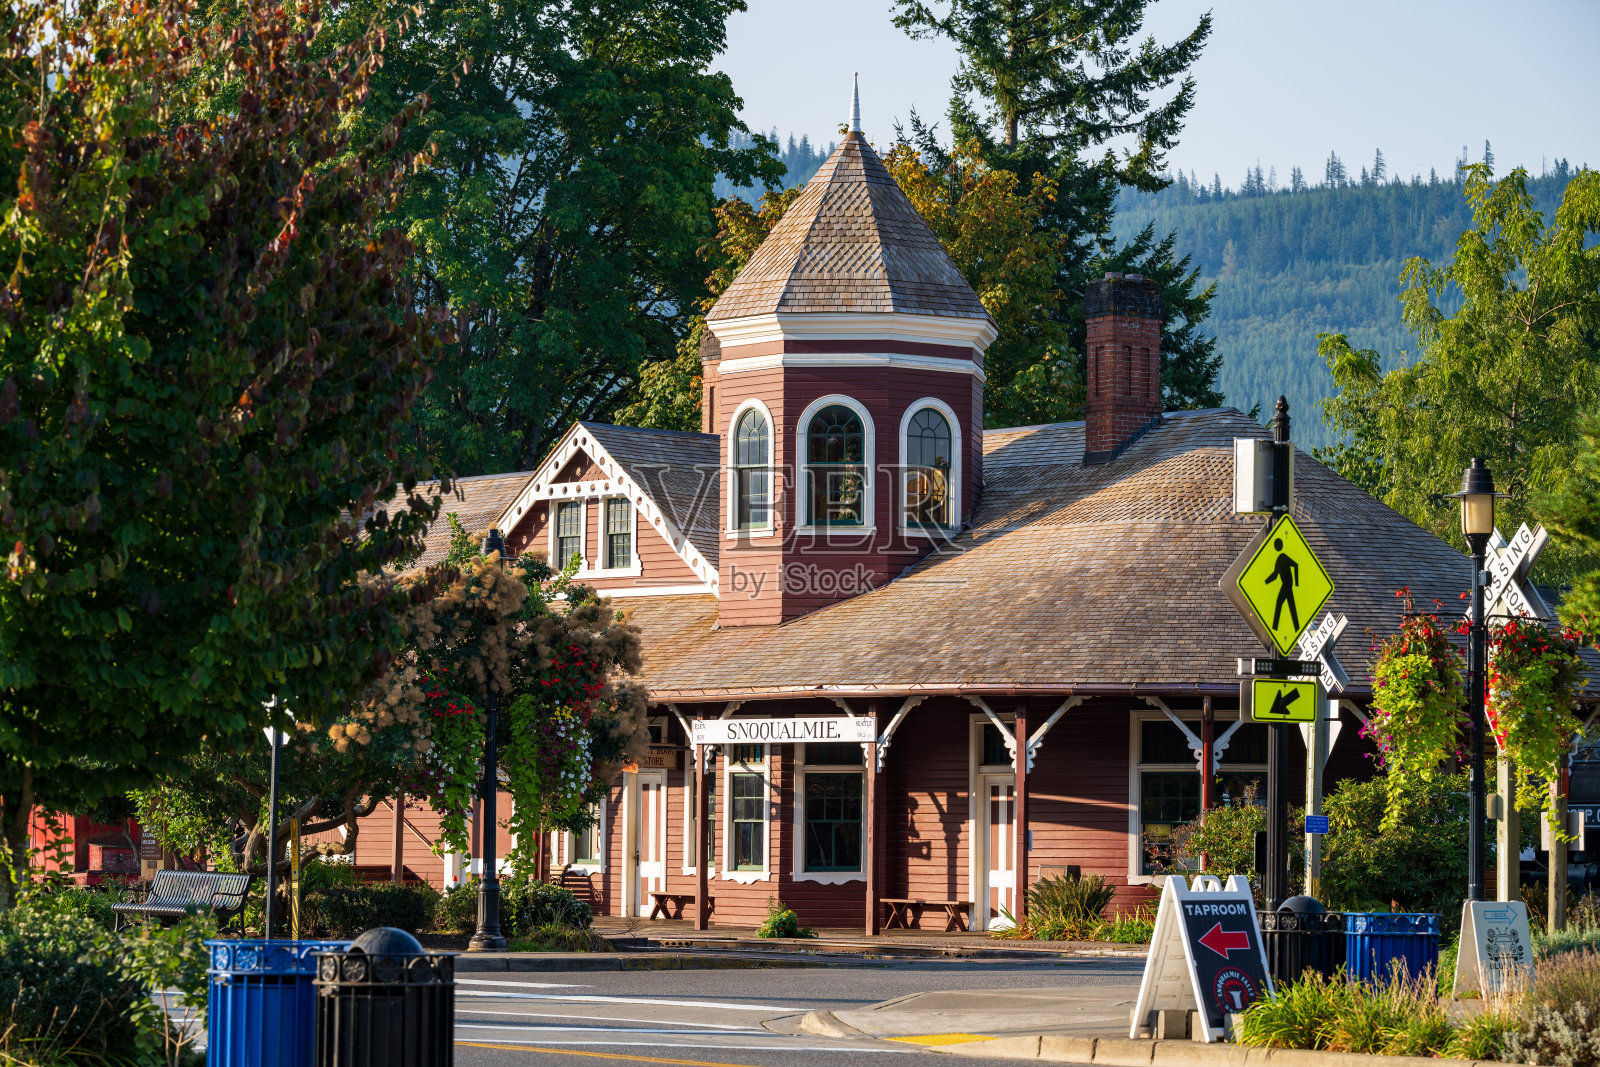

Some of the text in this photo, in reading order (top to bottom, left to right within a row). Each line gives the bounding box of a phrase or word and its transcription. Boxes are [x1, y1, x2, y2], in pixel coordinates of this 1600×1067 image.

[1484, 529, 1530, 602] OSSING
[727, 721, 841, 741] SNOQUALMIE.
[1185, 903, 1247, 916] TAPROOM
[1216, 970, 1255, 998] SNOQUALMIE FALLS
